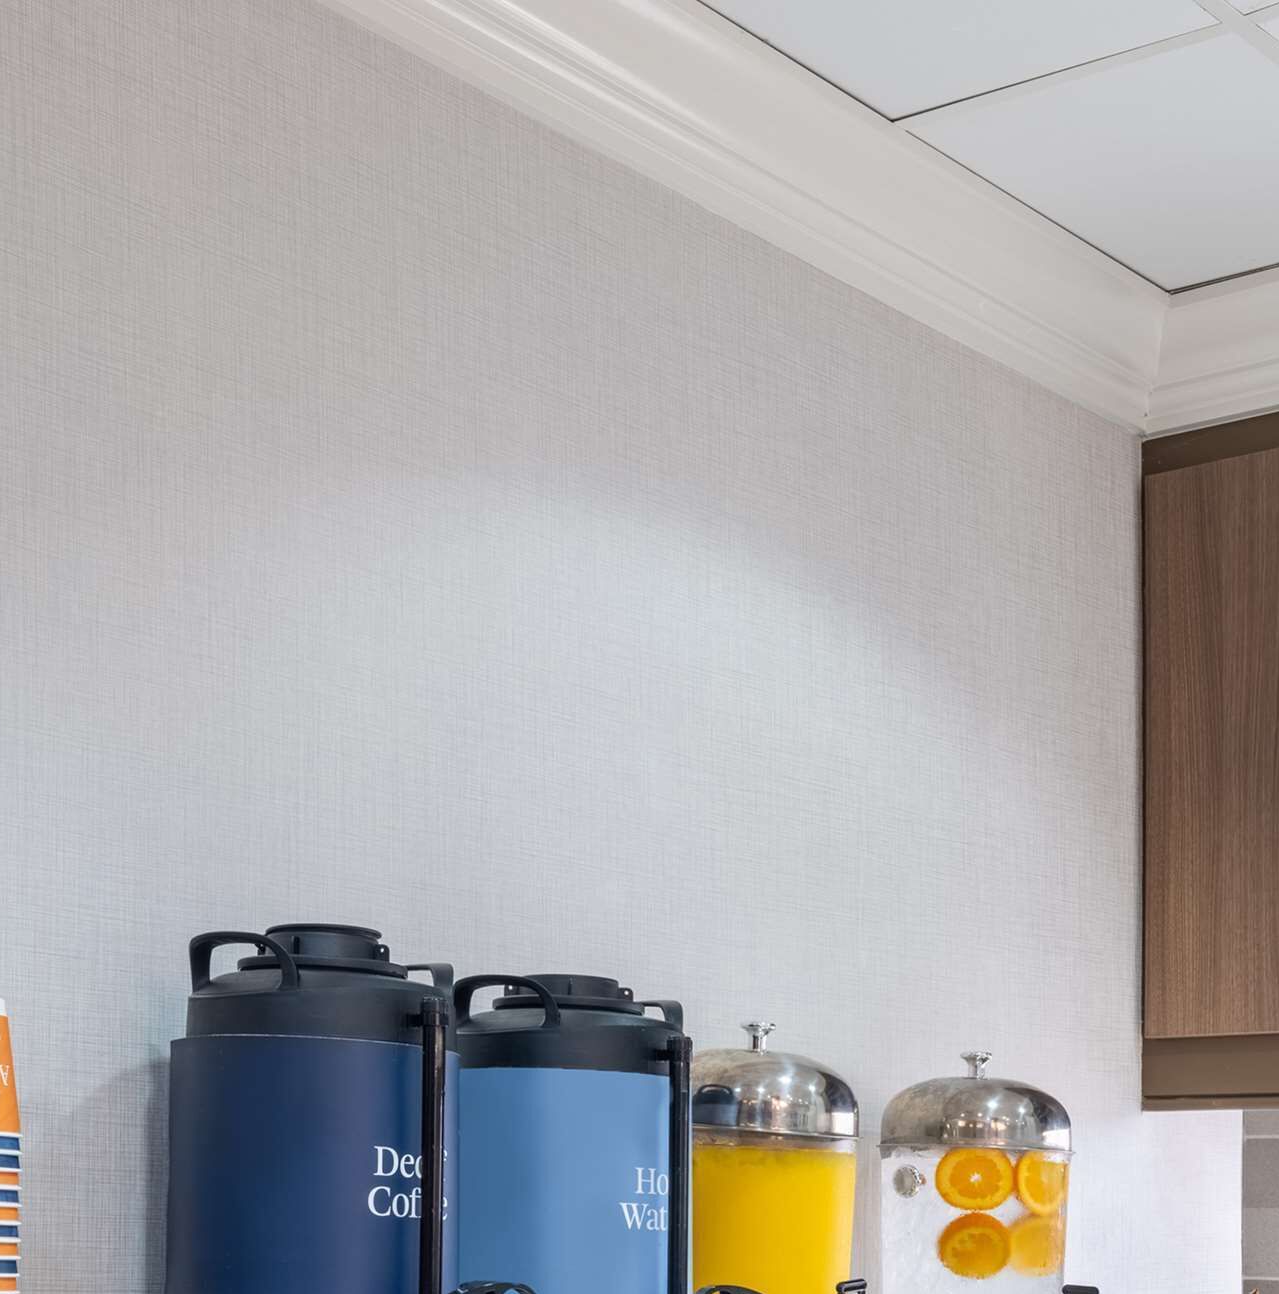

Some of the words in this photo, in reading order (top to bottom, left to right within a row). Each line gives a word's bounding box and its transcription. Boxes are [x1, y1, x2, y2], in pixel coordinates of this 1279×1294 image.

[373, 1145, 448, 1181] Dec
[633, 1166, 669, 1196] Ho
[367, 1185, 448, 1221] Cof
[618, 1201, 669, 1232] Wat
